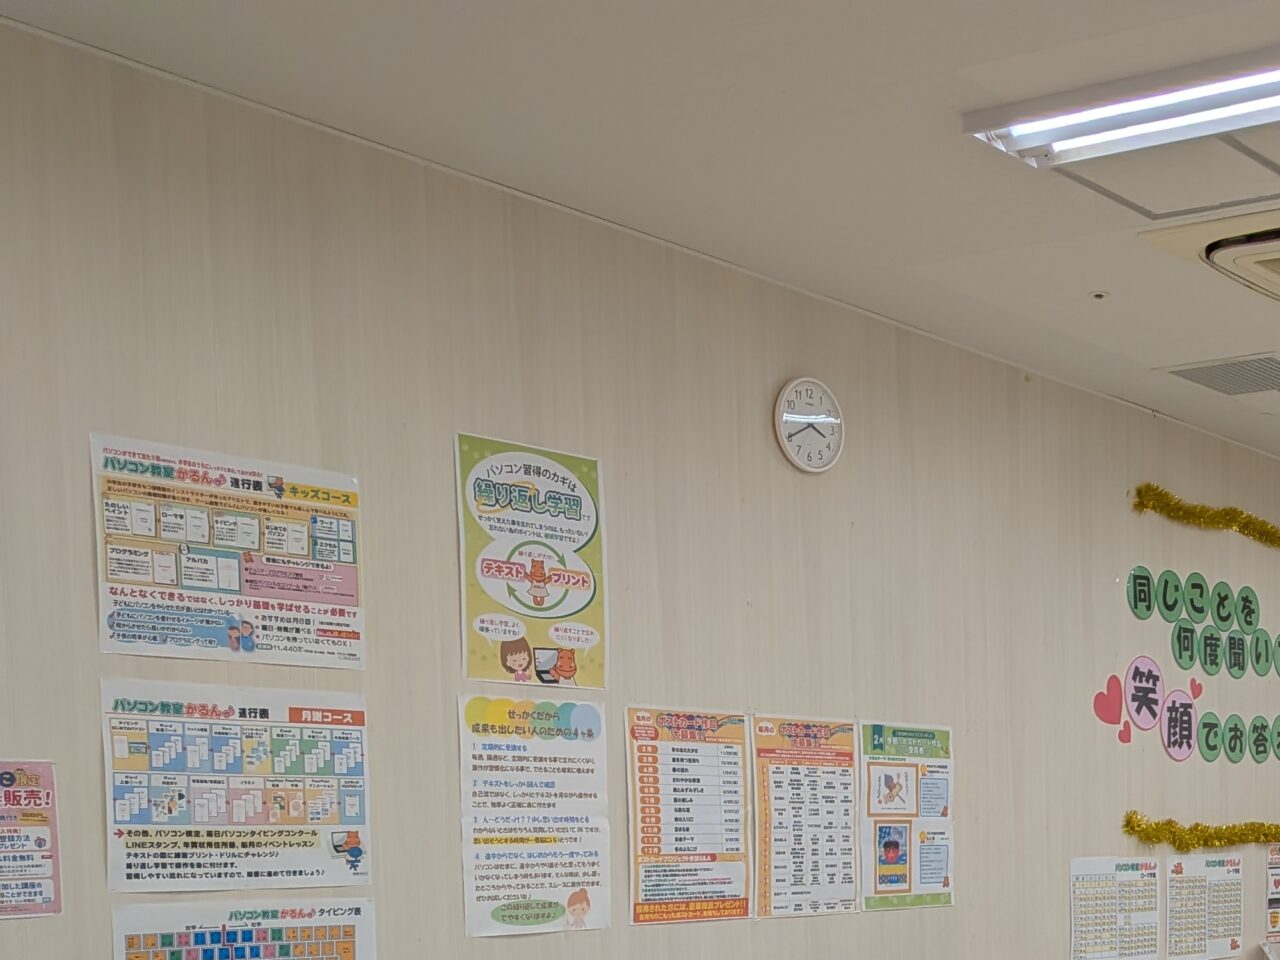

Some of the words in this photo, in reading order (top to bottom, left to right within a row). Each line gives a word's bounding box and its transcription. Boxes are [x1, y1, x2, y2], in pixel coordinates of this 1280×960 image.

[795, 389, 802, 400] 11
[805, 388, 813, 399] 12
[786, 399, 796, 410] 10
[830, 425, 835, 435] 3
[796, 445, 801, 456] 7
[826, 442, 831, 452] 4
[807, 452, 812, 462] 6
[818, 450, 823, 460] 5
[486, 463, 577, 493] パソコン習得のカギは
[230, 476, 262, 492] 進行表
[289, 486, 351, 505] キッズコース
[474, 481, 582, 520] 繰り返し学習
[483, 562, 524, 579] テキスト
[552, 571, 590, 588] プリント
[1132, 574, 1256, 628] 同じことを
[1130, 665, 1193, 751] 笑顔
[508, 710, 560, 721] せっかくだから
